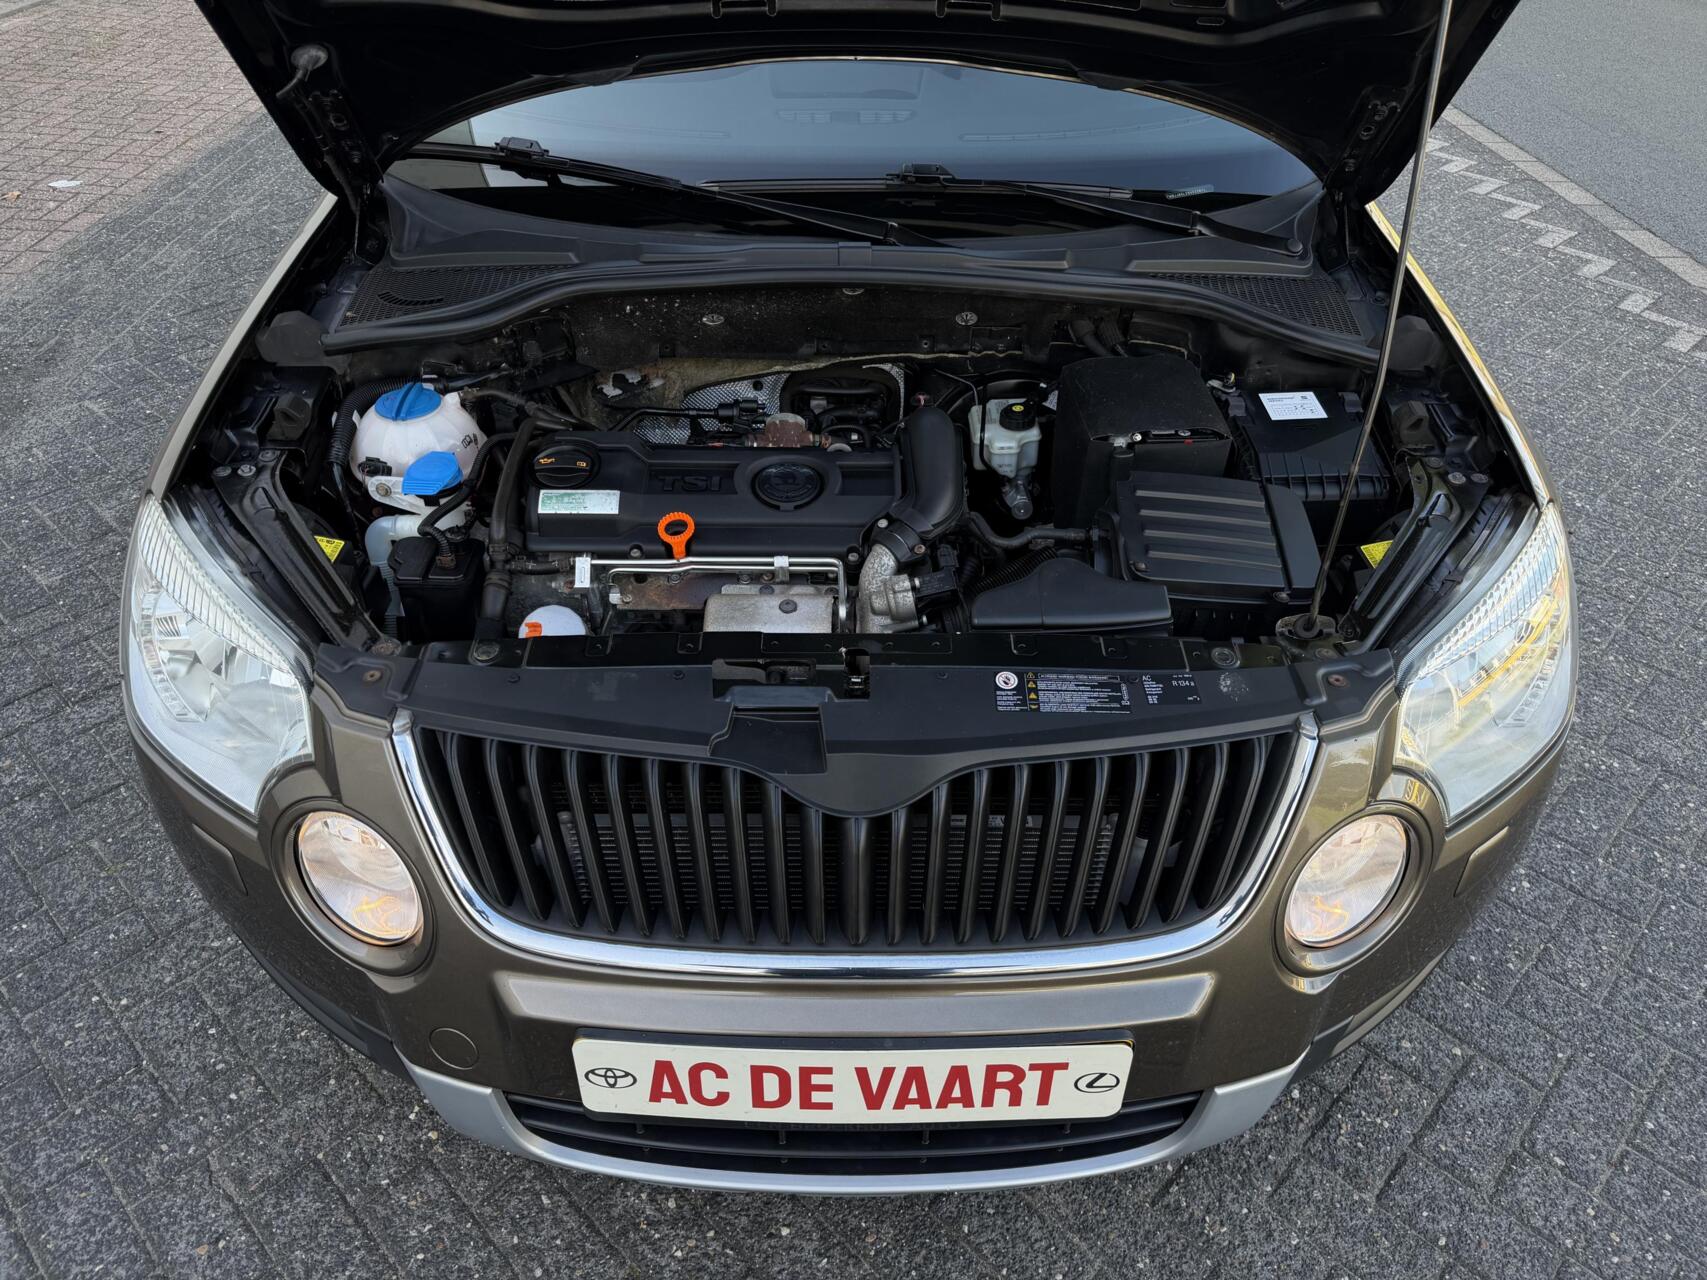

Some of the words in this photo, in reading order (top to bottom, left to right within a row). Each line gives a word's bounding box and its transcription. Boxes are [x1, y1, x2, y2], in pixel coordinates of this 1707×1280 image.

[658, 475, 720, 491] TSI
[649, 1060, 730, 1107] AC
[750, 1065, 833, 1110] DE
[854, 1062, 1069, 1110] VAART
